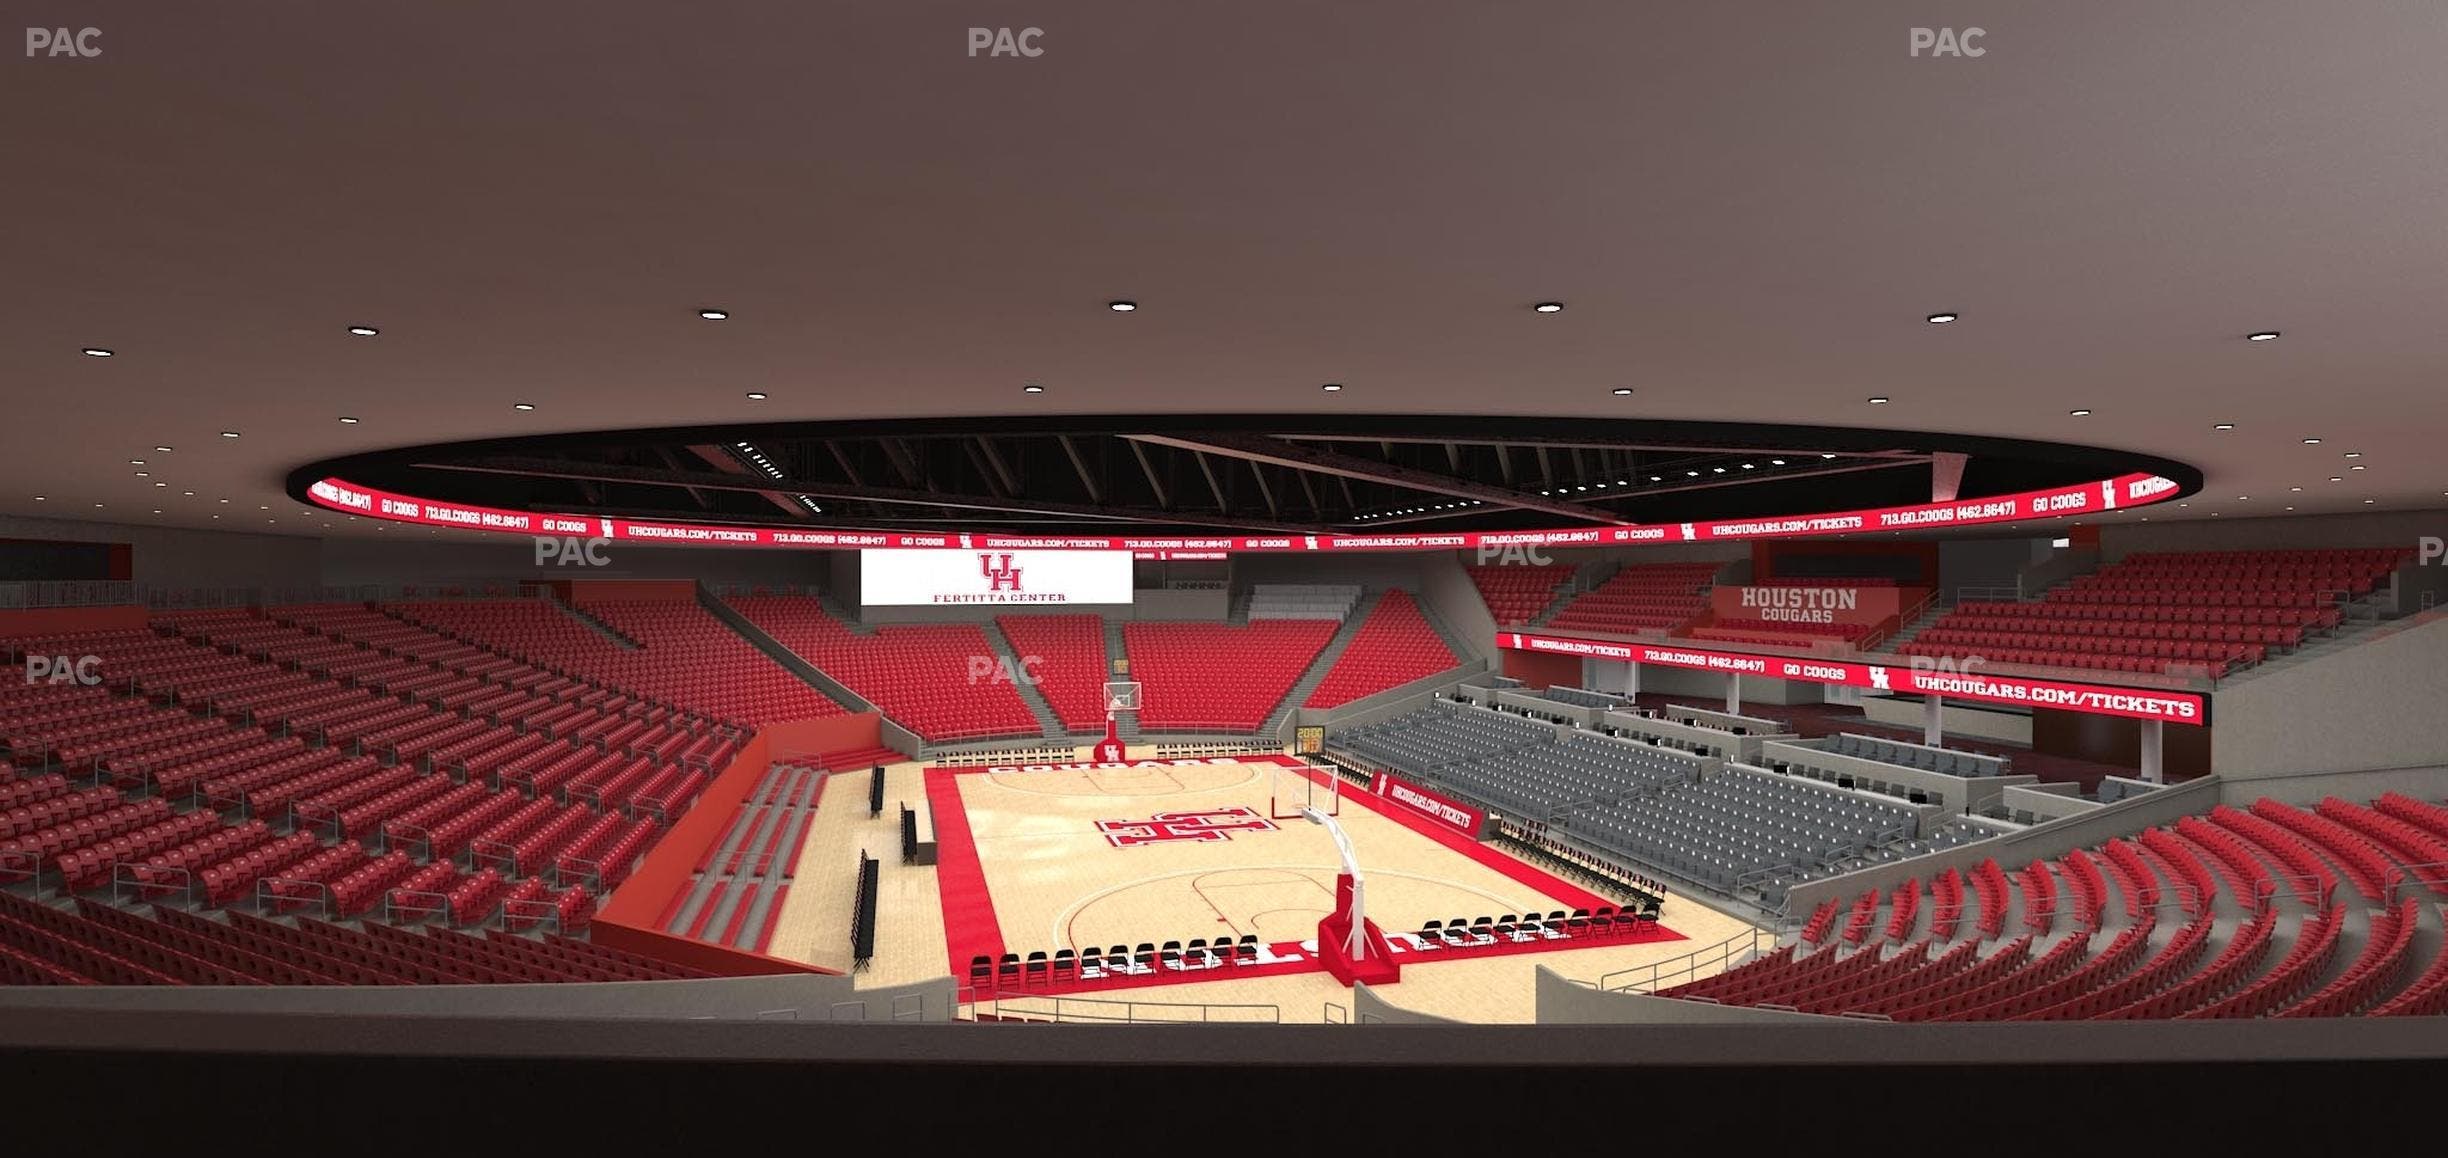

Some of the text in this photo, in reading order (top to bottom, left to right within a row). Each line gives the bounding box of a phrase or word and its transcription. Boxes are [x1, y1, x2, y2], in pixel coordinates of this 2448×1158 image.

[382, 499, 418, 517] GO COOGS
[2033, 492, 2086, 512] GO COOGS
[1881, 508, 1954, 525] 713.GO.COOGS
[543, 519, 586, 532] GO COOGS
[629, 526, 757, 541] UHCOUGARS.COM/TICKETS
[1615, 529, 1664, 539] GO COOGS
[1713, 517, 1862, 536] UHCOUGARS.COM/TICKETS
[901, 537, 945, 546] GO COOGS
[987, 539, 1109, 547] UHCOUGARS.COM/TICKETS
[1333, 537, 1464, 547] UHCOUGARS.COM/TICKETS
[978, 553, 1023, 592] UH
[933, 593, 1067, 603] FERTITTA CENTER
[1741, 586, 1857, 610] HOUSTON
[1761, 607, 1833, 624] COUGARS
[1532, 639, 1630, 657] UHCOUGARS.COM/TICKETS
[1645, 651, 1706, 665] 713.GO.COOGS
[1784, 664, 1845, 680] GO COOGS
[1915, 676, 2195, 717] UHCOUGARS.COM/TICKETS
[1392, 784, 1472, 829] UHCOUGARS.COM/TICKETS
